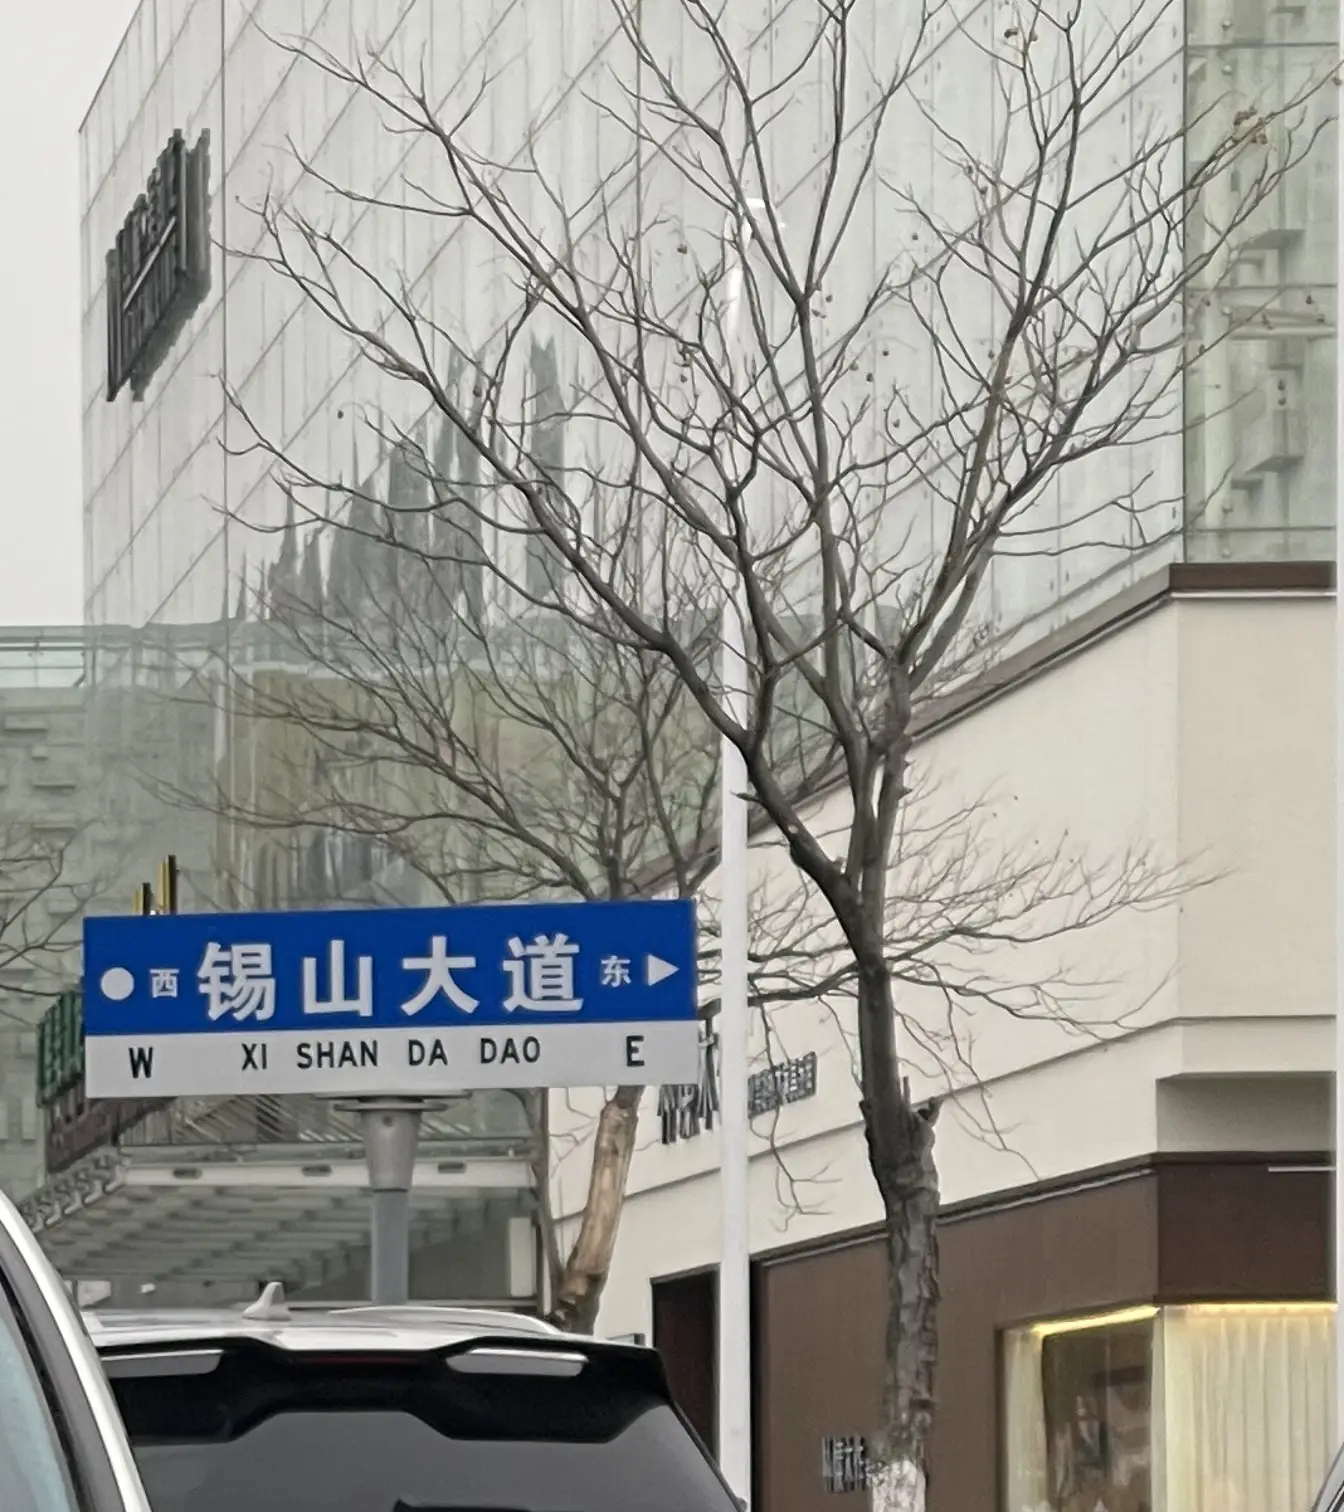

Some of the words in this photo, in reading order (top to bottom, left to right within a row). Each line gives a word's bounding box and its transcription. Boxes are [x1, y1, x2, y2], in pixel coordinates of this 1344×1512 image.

[150, 968, 180, 998] 西
[198, 934, 584, 1021] 锡山大道
[601, 955, 632, 988] 东
[129, 1046, 154, 1080] W
[241, 1043, 268, 1071] XI
[296, 1040, 379, 1070] SHAN
[408, 1038, 449, 1067] DA
[480, 1036, 541, 1064] DAO
[626, 1035, 645, 1067] E
